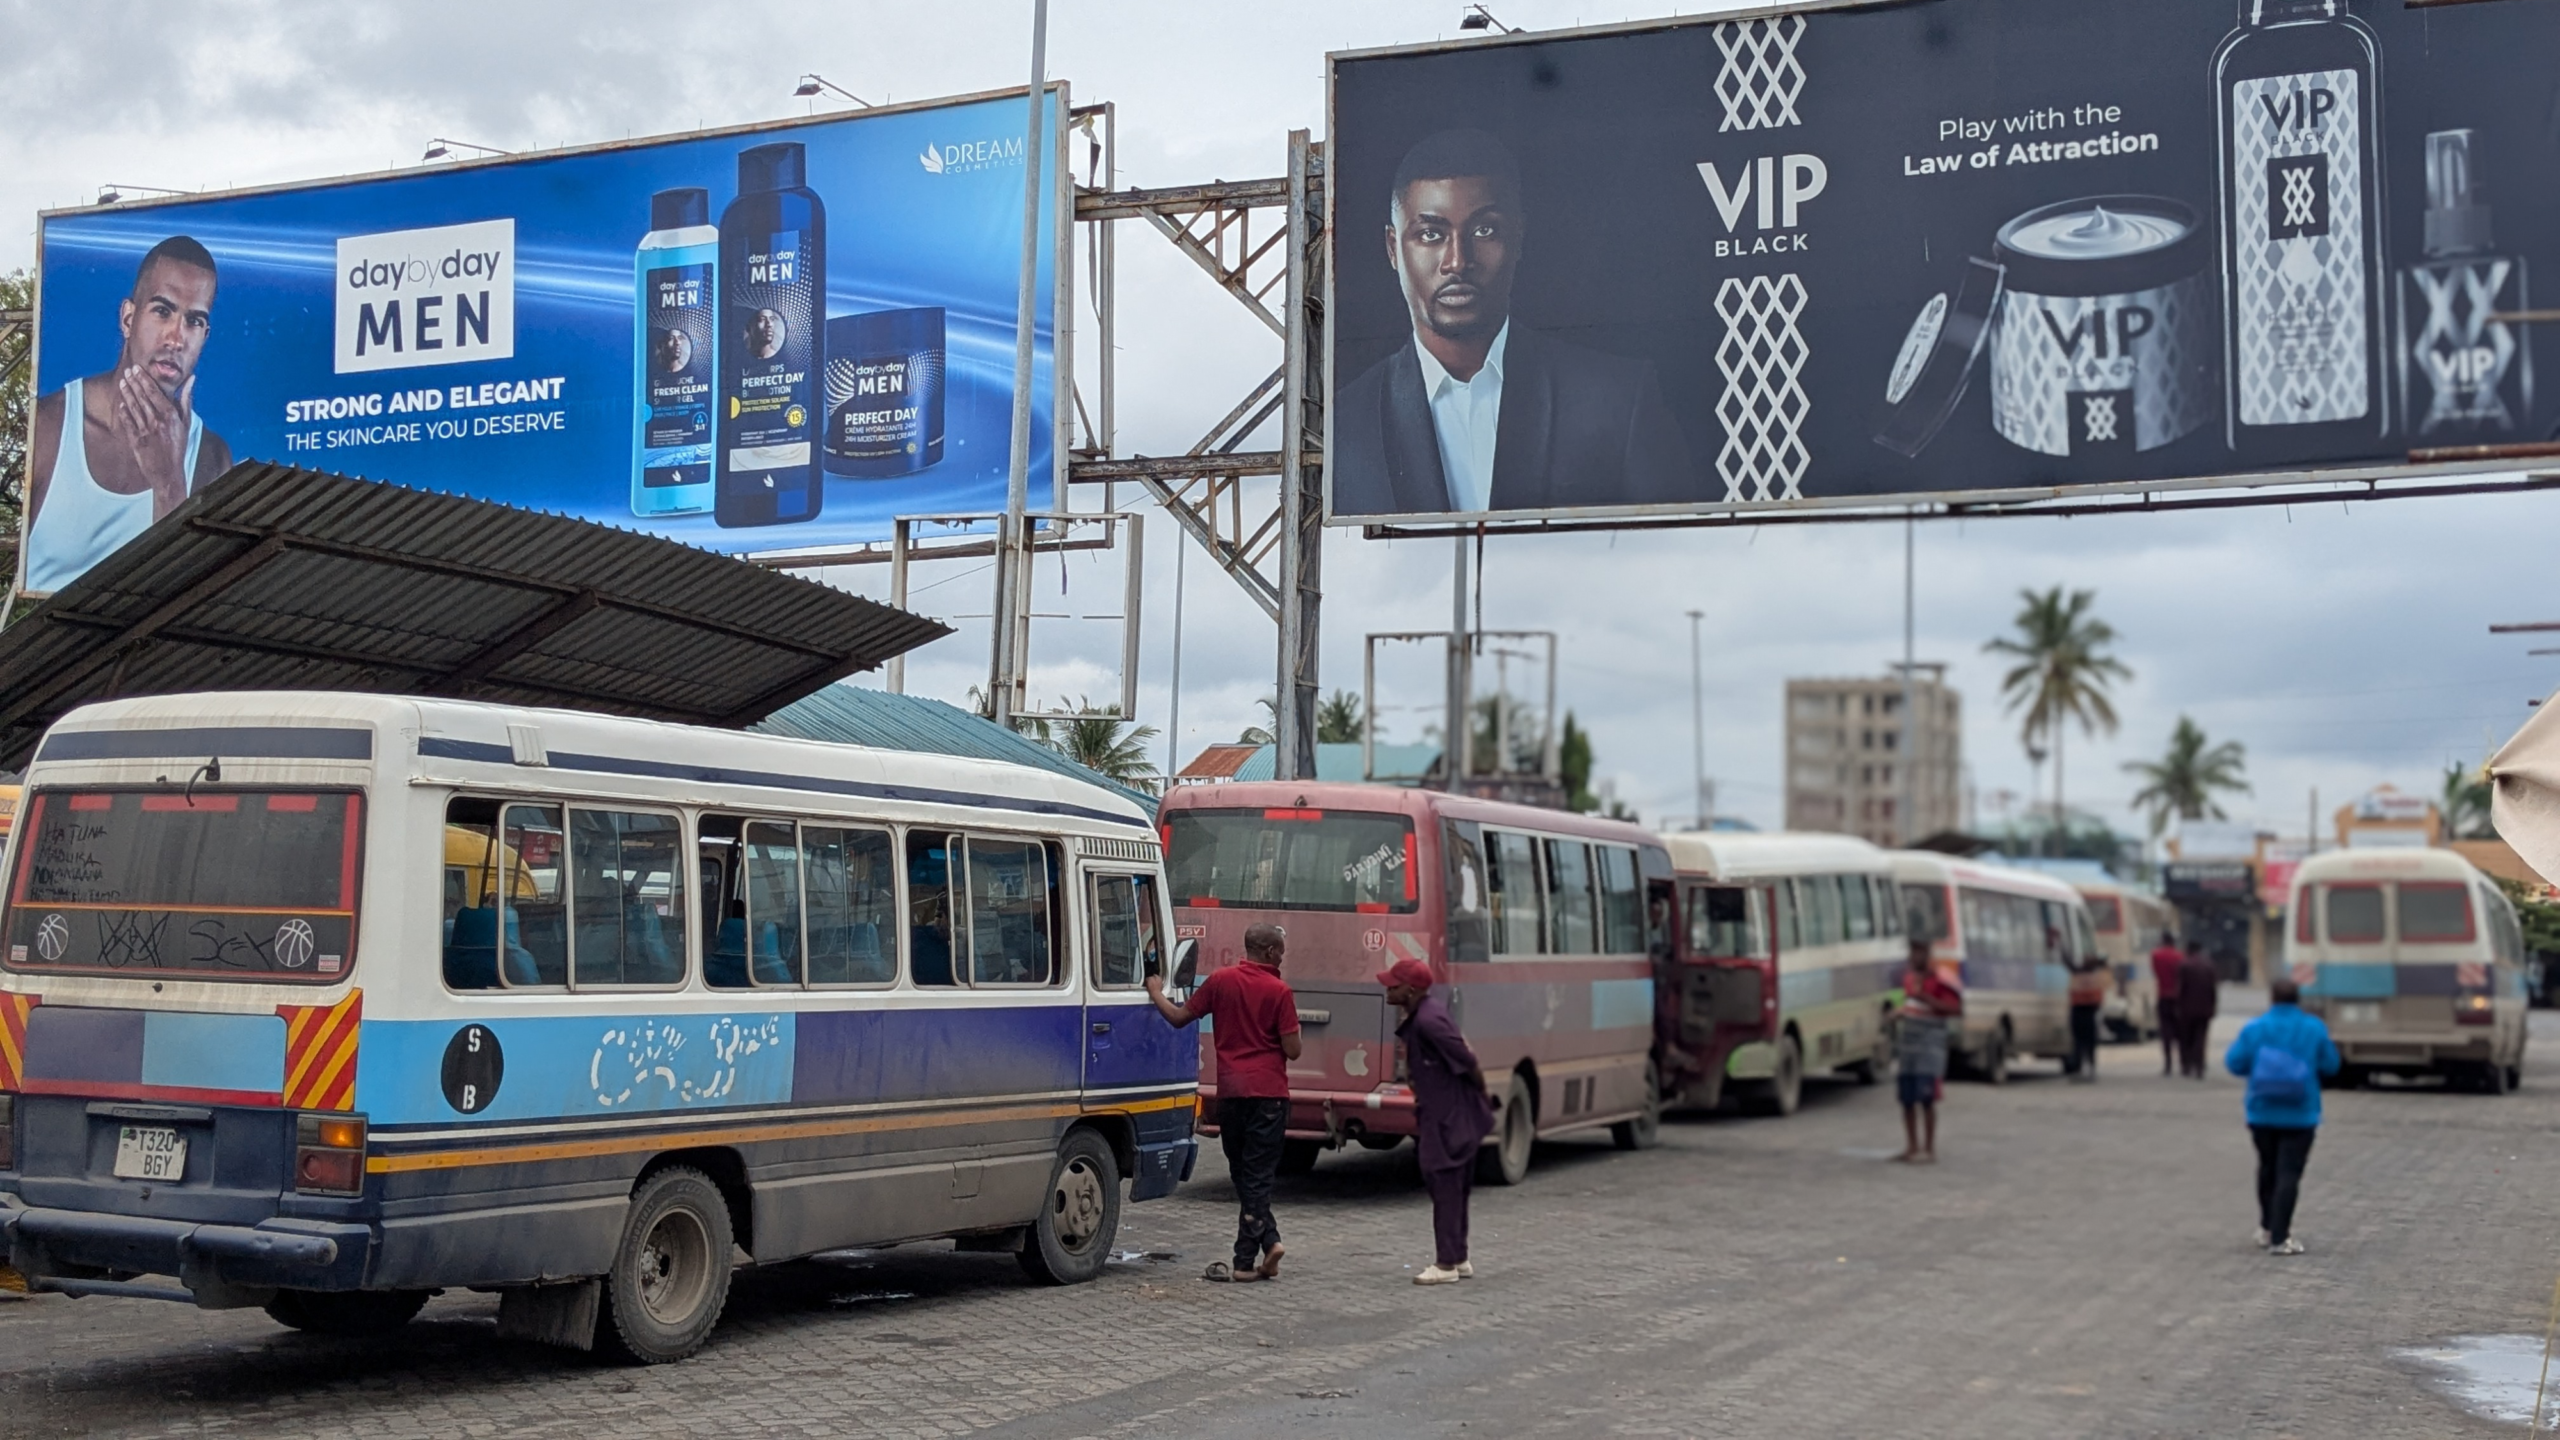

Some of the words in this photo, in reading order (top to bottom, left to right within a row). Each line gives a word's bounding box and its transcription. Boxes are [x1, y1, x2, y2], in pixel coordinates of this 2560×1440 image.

[1939, 117, 1998, 142] Play
[2003, 107, 2065, 134] with
[2073, 103, 2122, 127] the
[2259, 88, 2335, 132] VIP
[945, 136, 1023, 165] DREAM
[2271, 131, 2326, 145] BLACK
[945, 157, 1023, 174] COSMETICS
[1904, 155, 1963, 176] Law
[1969, 144, 2001, 169] of
[2005, 131, 2159, 166] Attraction
[1696, 153, 1828, 234] VIP
[1714, 233, 1809, 258] BLACK
[349, 248, 501, 292] daybyday
[750, 262, 793, 284] MEN
[661, 289, 698, 308] MEN
[355, 290, 490, 357] MEN
[2039, 305, 2155, 360] VIP
[2430, 346, 2495, 382] VIP
[654, 386, 680, 397] FRESH
[681, 383, 709, 395] CLEAN
[742, 374, 784, 388] PERFECT
[785, 371, 805, 384] DAY
[857, 374, 903, 396] MEN
[285, 394, 382, 423] STRONG
[387, 388, 444, 414] AND
[450, 377, 566, 409] ELEGANT
[791, 412, 800, 422] 15
[844, 410, 892, 426] PERFECT
[894, 406, 919, 422] DAY
[285, 432, 322, 452] THE
[326, 423, 422, 449] SKINCARE
[425, 419, 468, 440] YOU
[474, 411, 566, 436] DESERVE
[1179, 927, 1201, 936] PSV
[467, 1028, 482, 1053] S
[462, 1084, 477, 1110] B
[139, 1130, 176, 1153] T320
[143, 1154, 173, 1177] BGY
